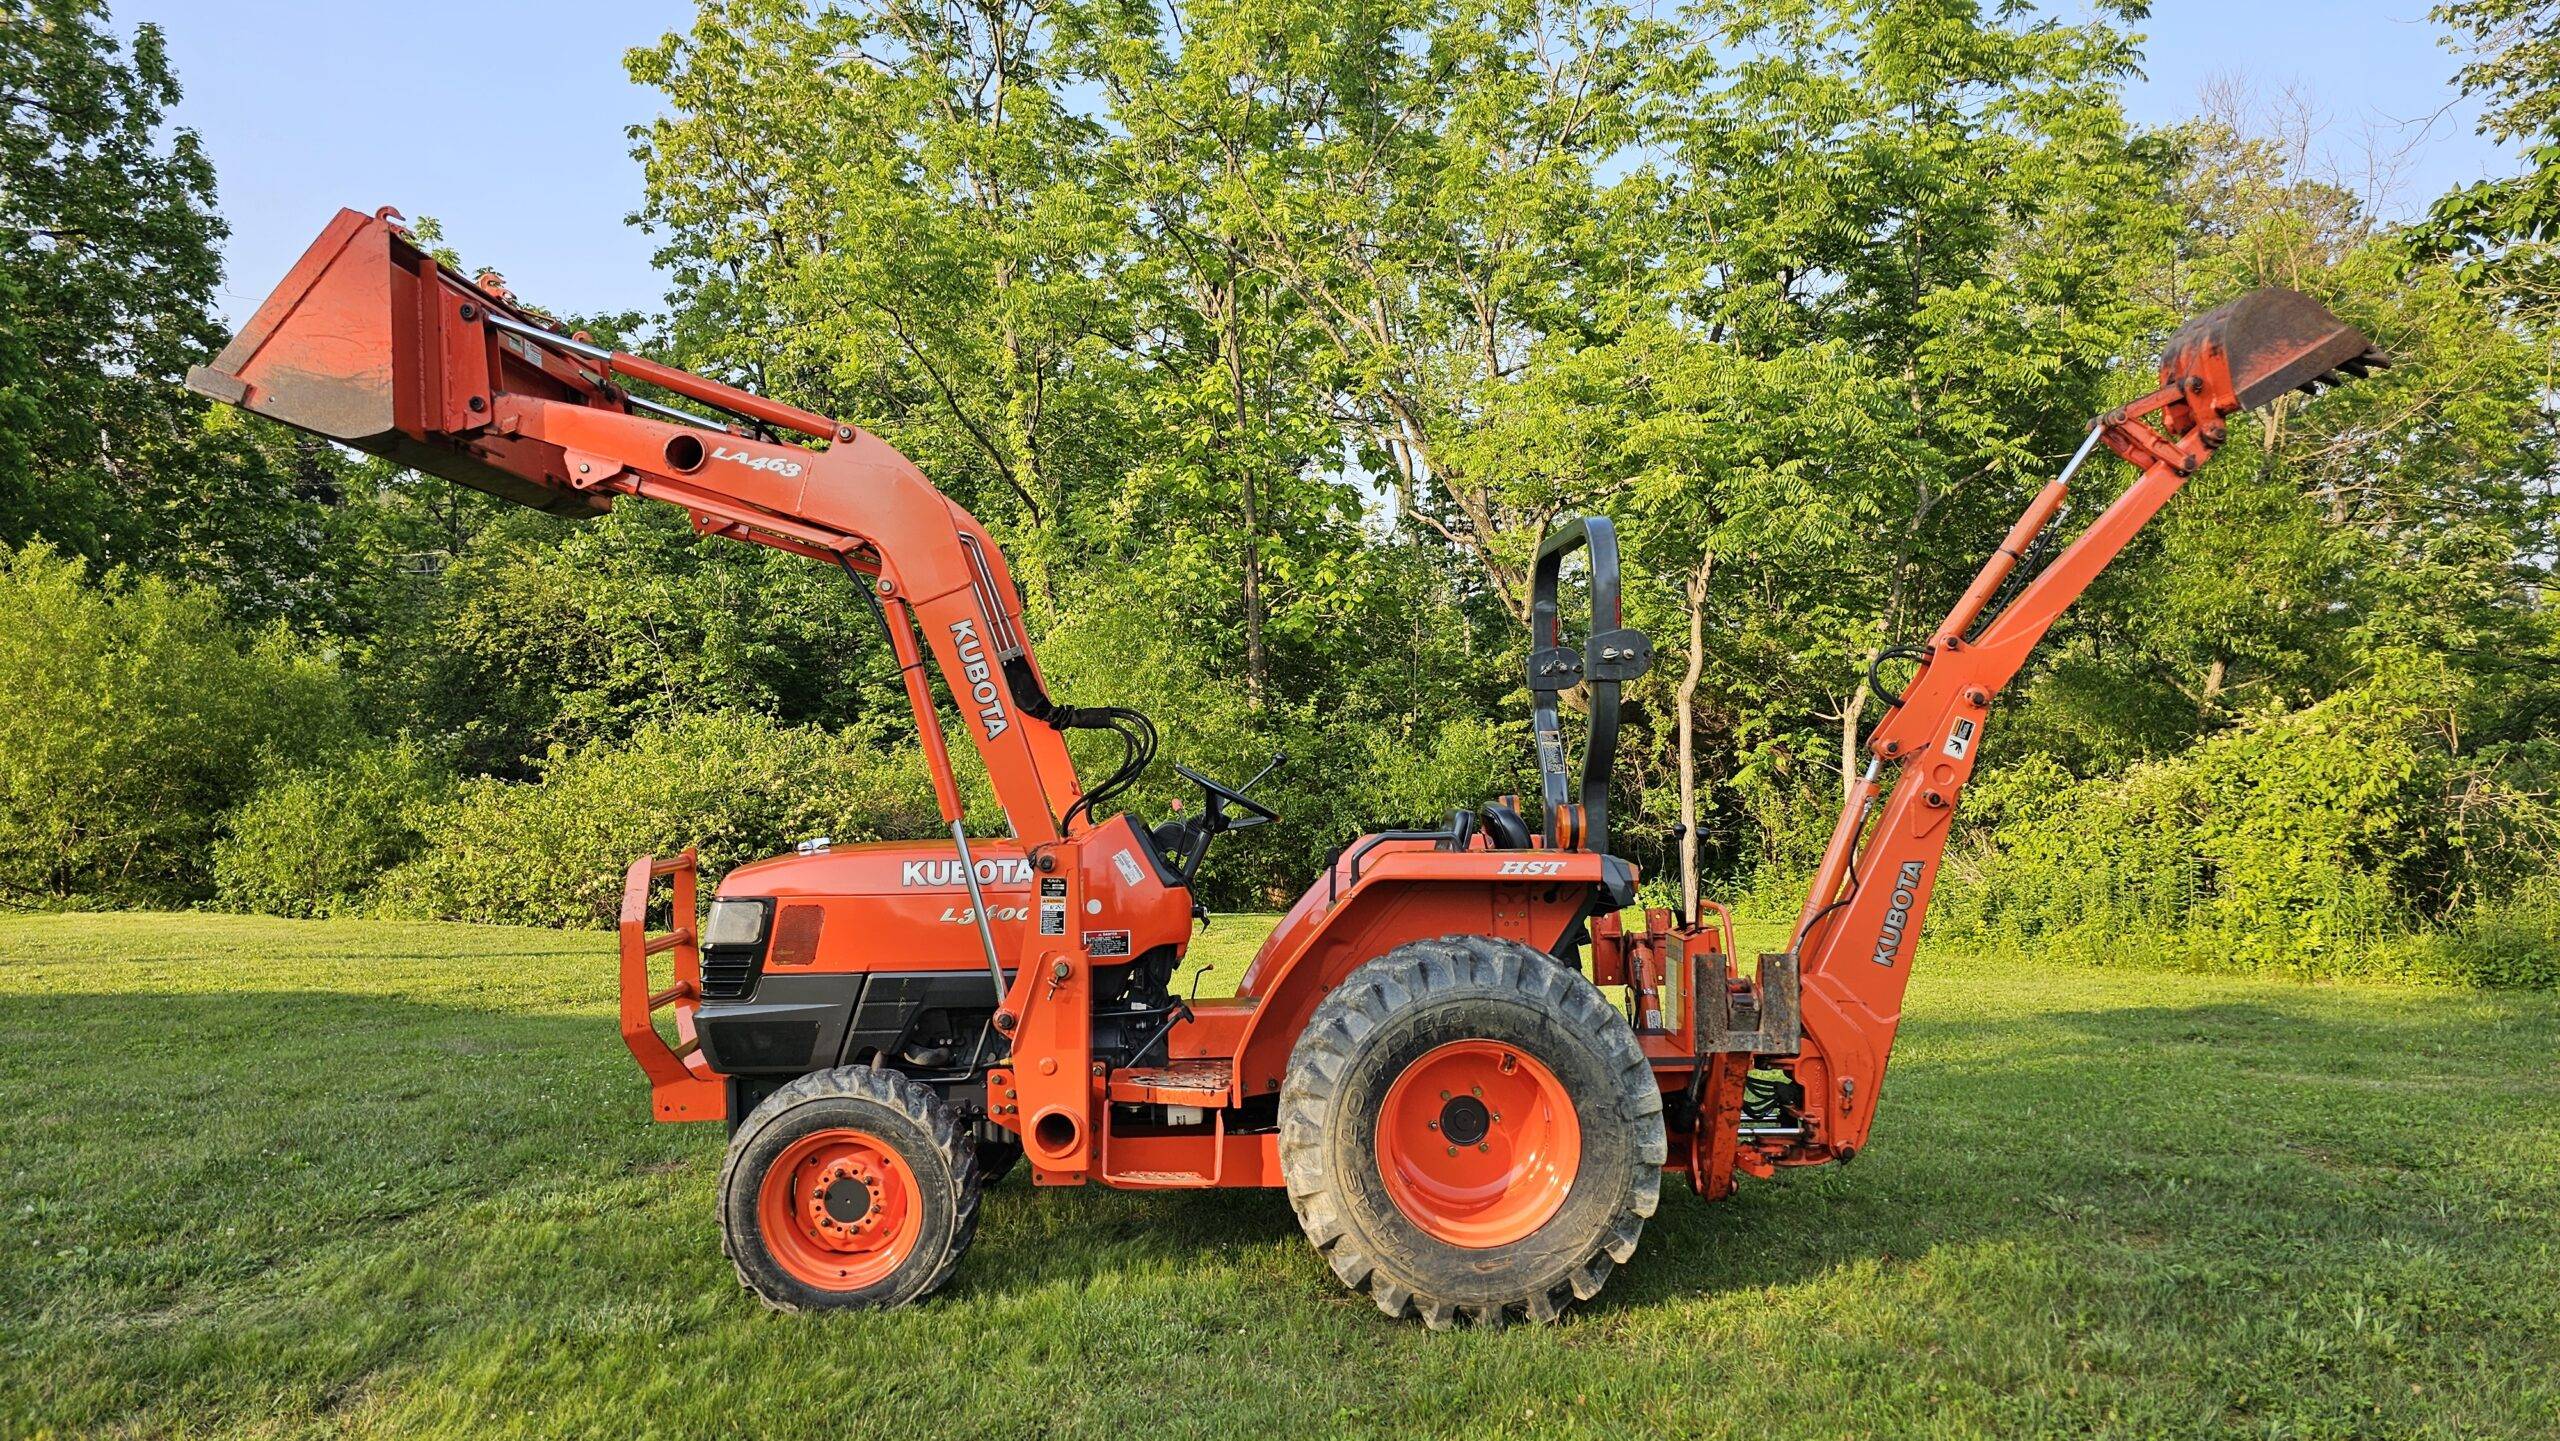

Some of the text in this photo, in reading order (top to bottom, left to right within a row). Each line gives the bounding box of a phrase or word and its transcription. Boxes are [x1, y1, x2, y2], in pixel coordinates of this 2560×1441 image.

[711, 447, 803, 477] LA463
[949, 618, 1009, 742] KUBOTA
[1497, 861, 1567, 875] HST
[1872, 861, 1924, 967] KUBOTA
[1341, 1005, 1466, 1268] TRAC LOADER
